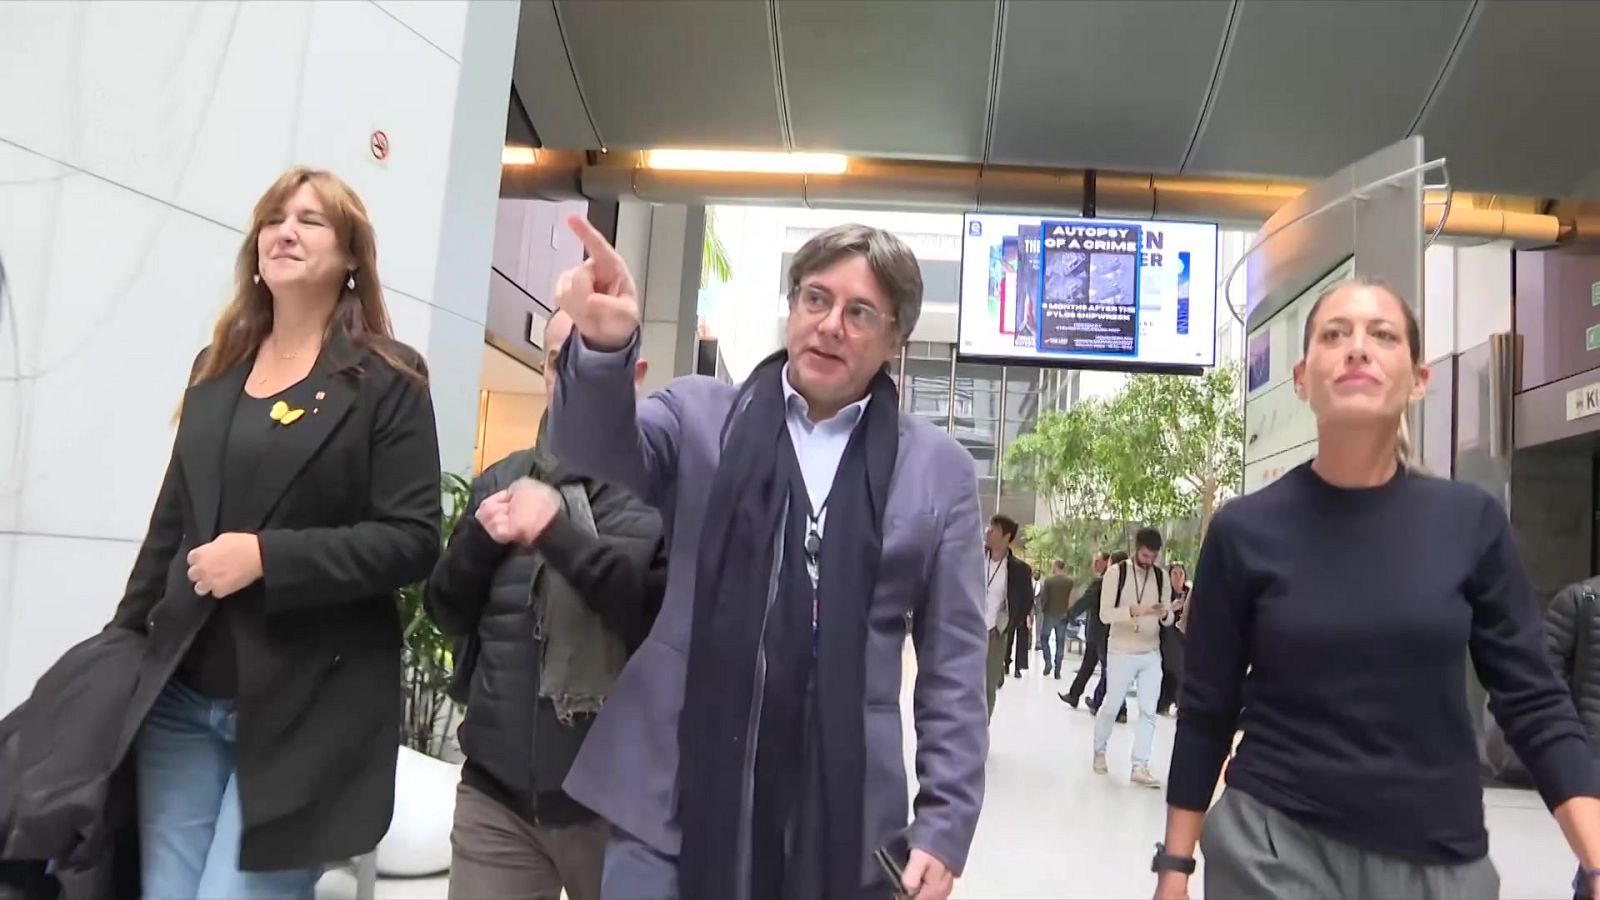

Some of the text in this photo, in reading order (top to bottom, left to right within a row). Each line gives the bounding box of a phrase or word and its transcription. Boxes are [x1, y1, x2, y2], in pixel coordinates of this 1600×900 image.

[1053, 225, 1129, 238] AUTOPSY
[1044, 238, 1136, 252] OF A CRIME
[1140, 231, 1163, 249] N
[1088, 304, 1117, 312] AFTER
[1077, 312, 1130, 321] SHIPWRECK
